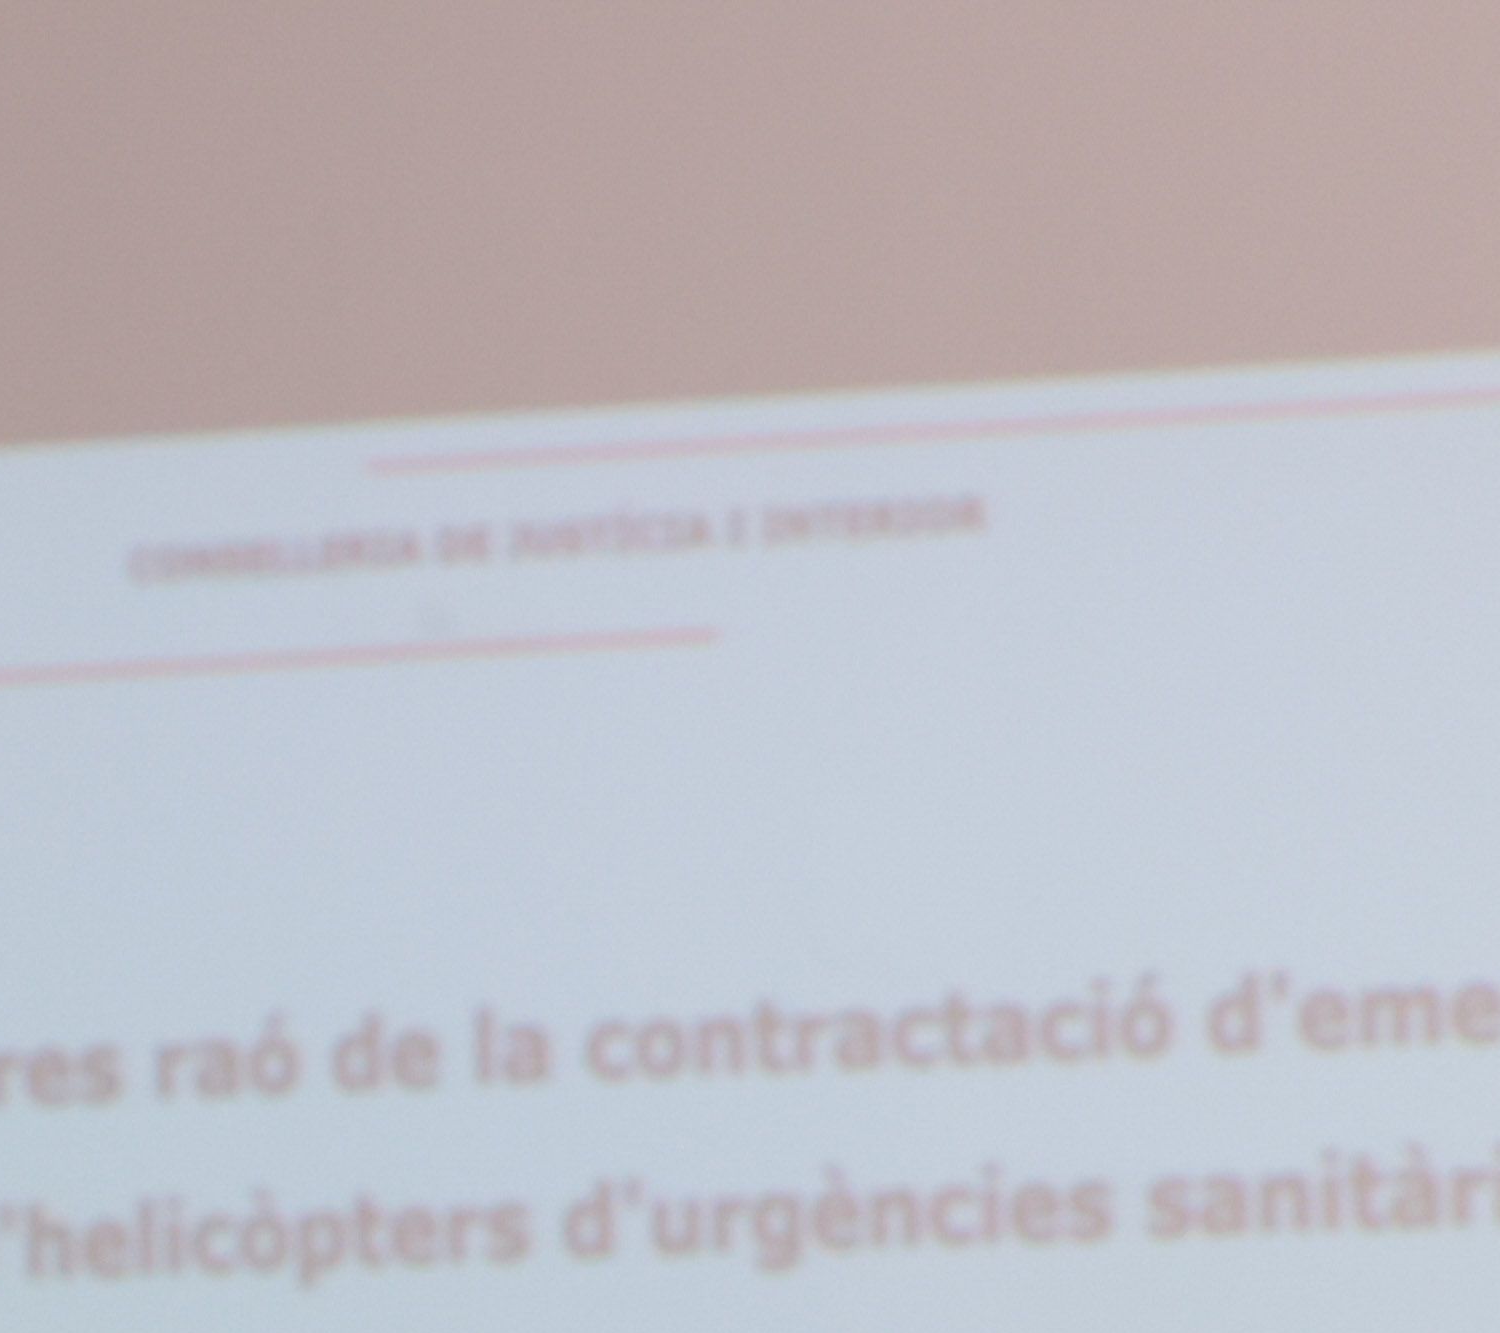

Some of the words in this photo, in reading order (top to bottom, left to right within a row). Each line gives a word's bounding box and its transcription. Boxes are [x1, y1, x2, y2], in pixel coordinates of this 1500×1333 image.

[152, 1011, 304, 1100] raó
[328, 1010, 444, 1094] de
[472, 1005, 555, 1086] la
[583, 971, 1177, 1080] contractació
[560, 1170, 1117, 1273] d'urgències
